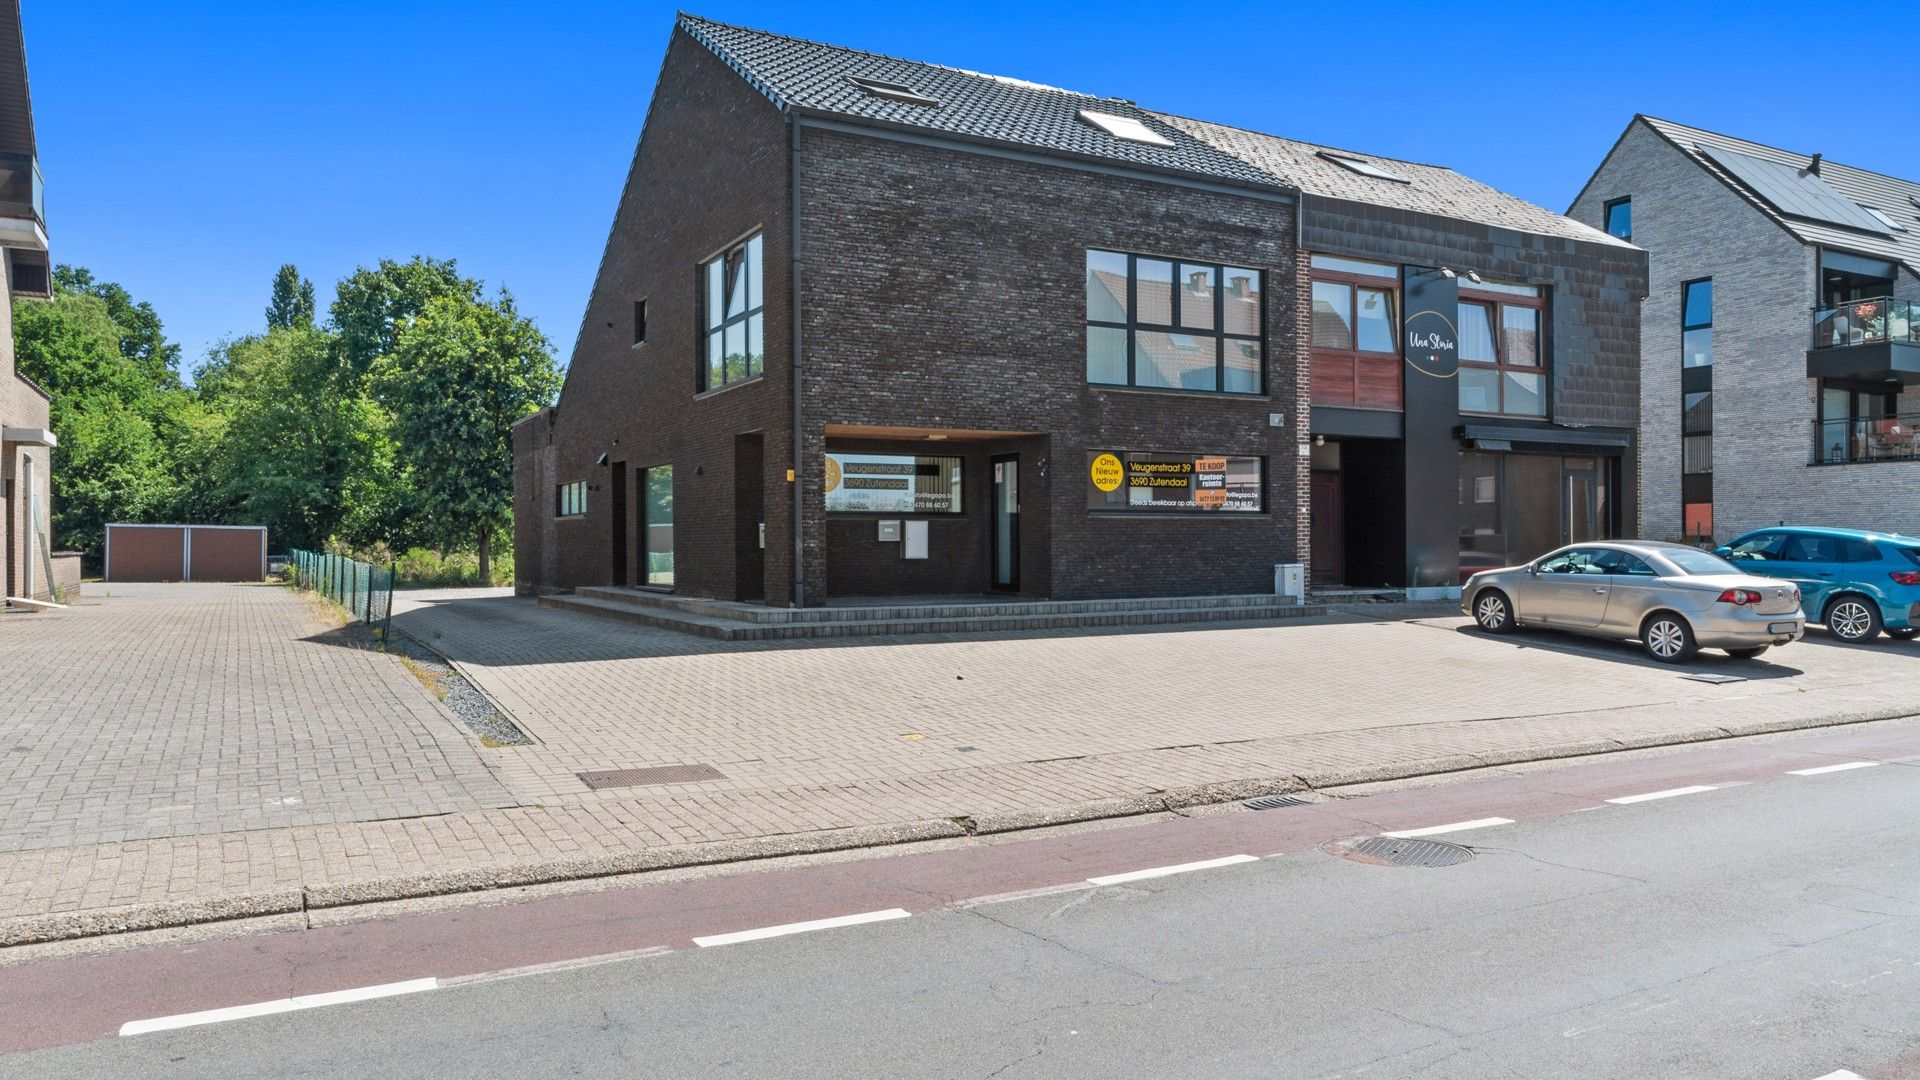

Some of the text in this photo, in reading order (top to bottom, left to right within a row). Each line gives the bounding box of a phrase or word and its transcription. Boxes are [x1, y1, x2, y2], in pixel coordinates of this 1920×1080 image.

[1410, 331, 1454, 350] Una Storia
[1100, 458, 1115, 466] Ons
[1207, 462, 1225, 470] KOOP
[845, 464, 913, 475] Veugenstraat 39
[1096, 467, 1119, 475] Nieuw
[1130, 463, 1191, 474] Veugenstraat 39
[845, 478, 908, 489] 3690 Zutendaal
[1096, 477, 1119, 485] adres:
[1130, 477, 1188, 487] 3690 Zutendaal
